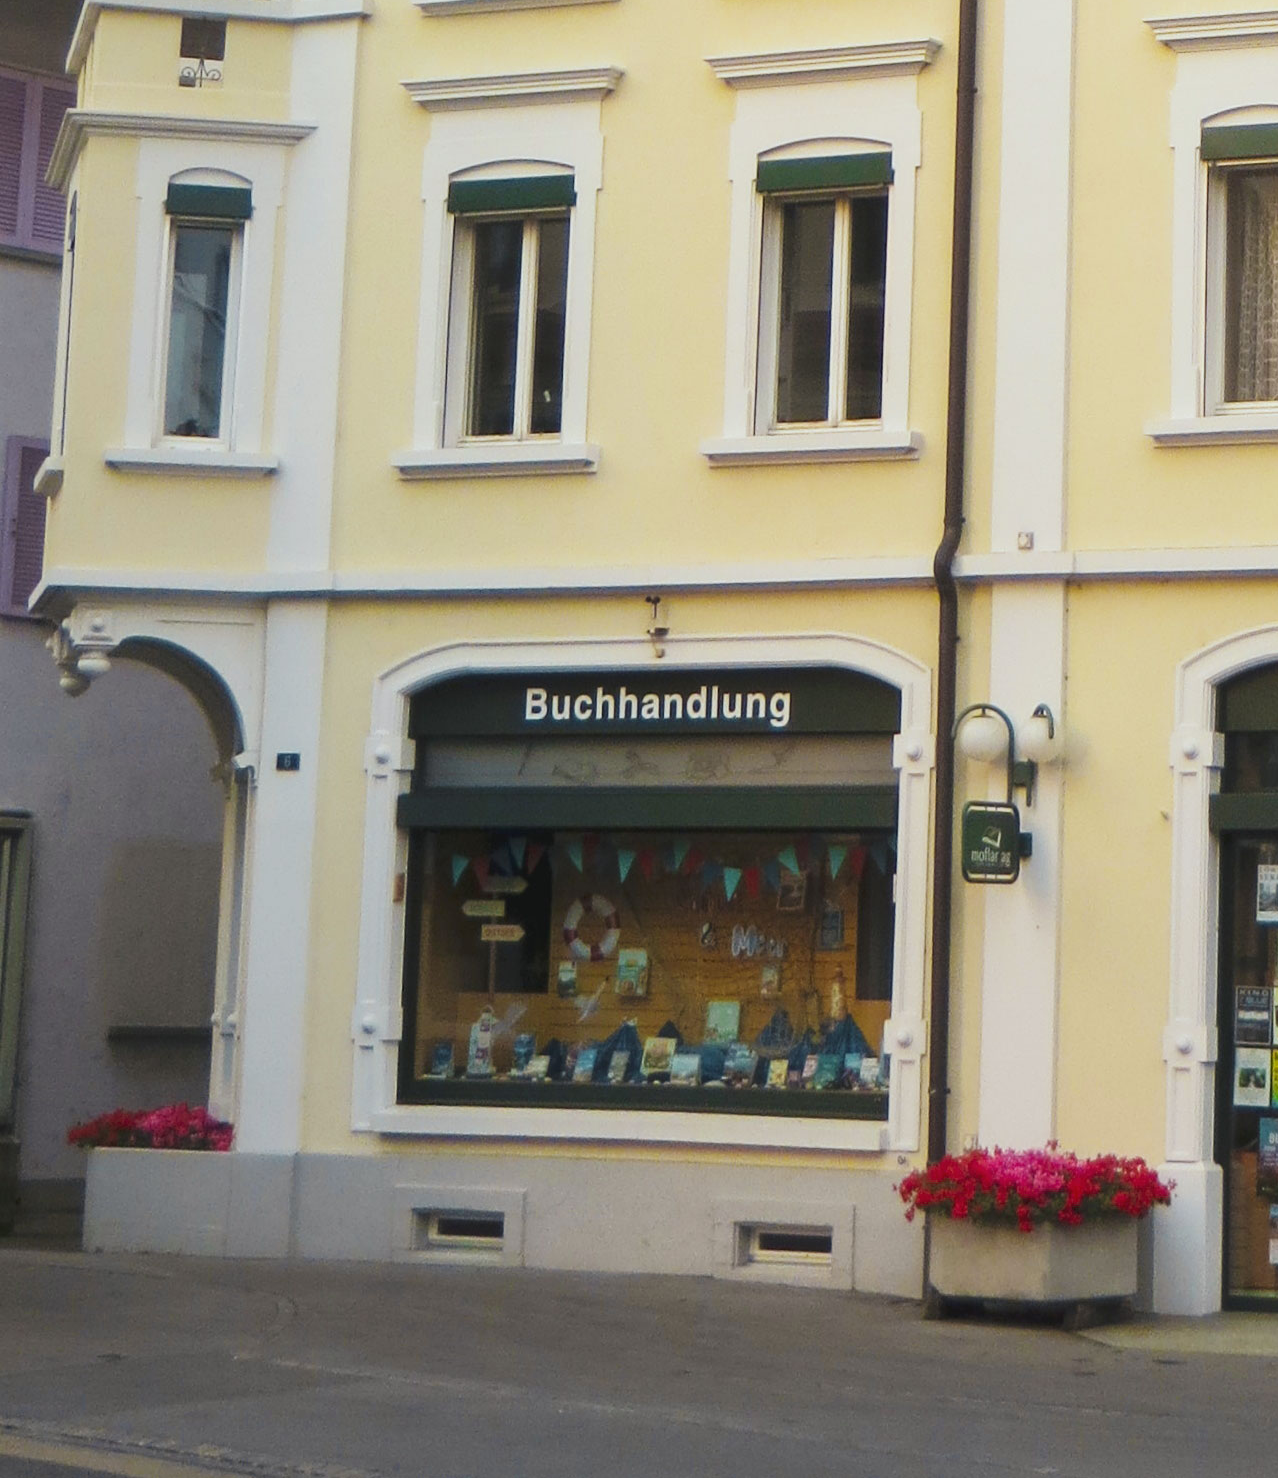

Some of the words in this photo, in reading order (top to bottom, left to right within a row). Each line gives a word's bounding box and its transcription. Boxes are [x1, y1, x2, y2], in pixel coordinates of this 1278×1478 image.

[525, 686, 791, 728] Buchhandlung
[971, 847, 999, 862] moflar
[1001, 851, 1011, 867] ag
